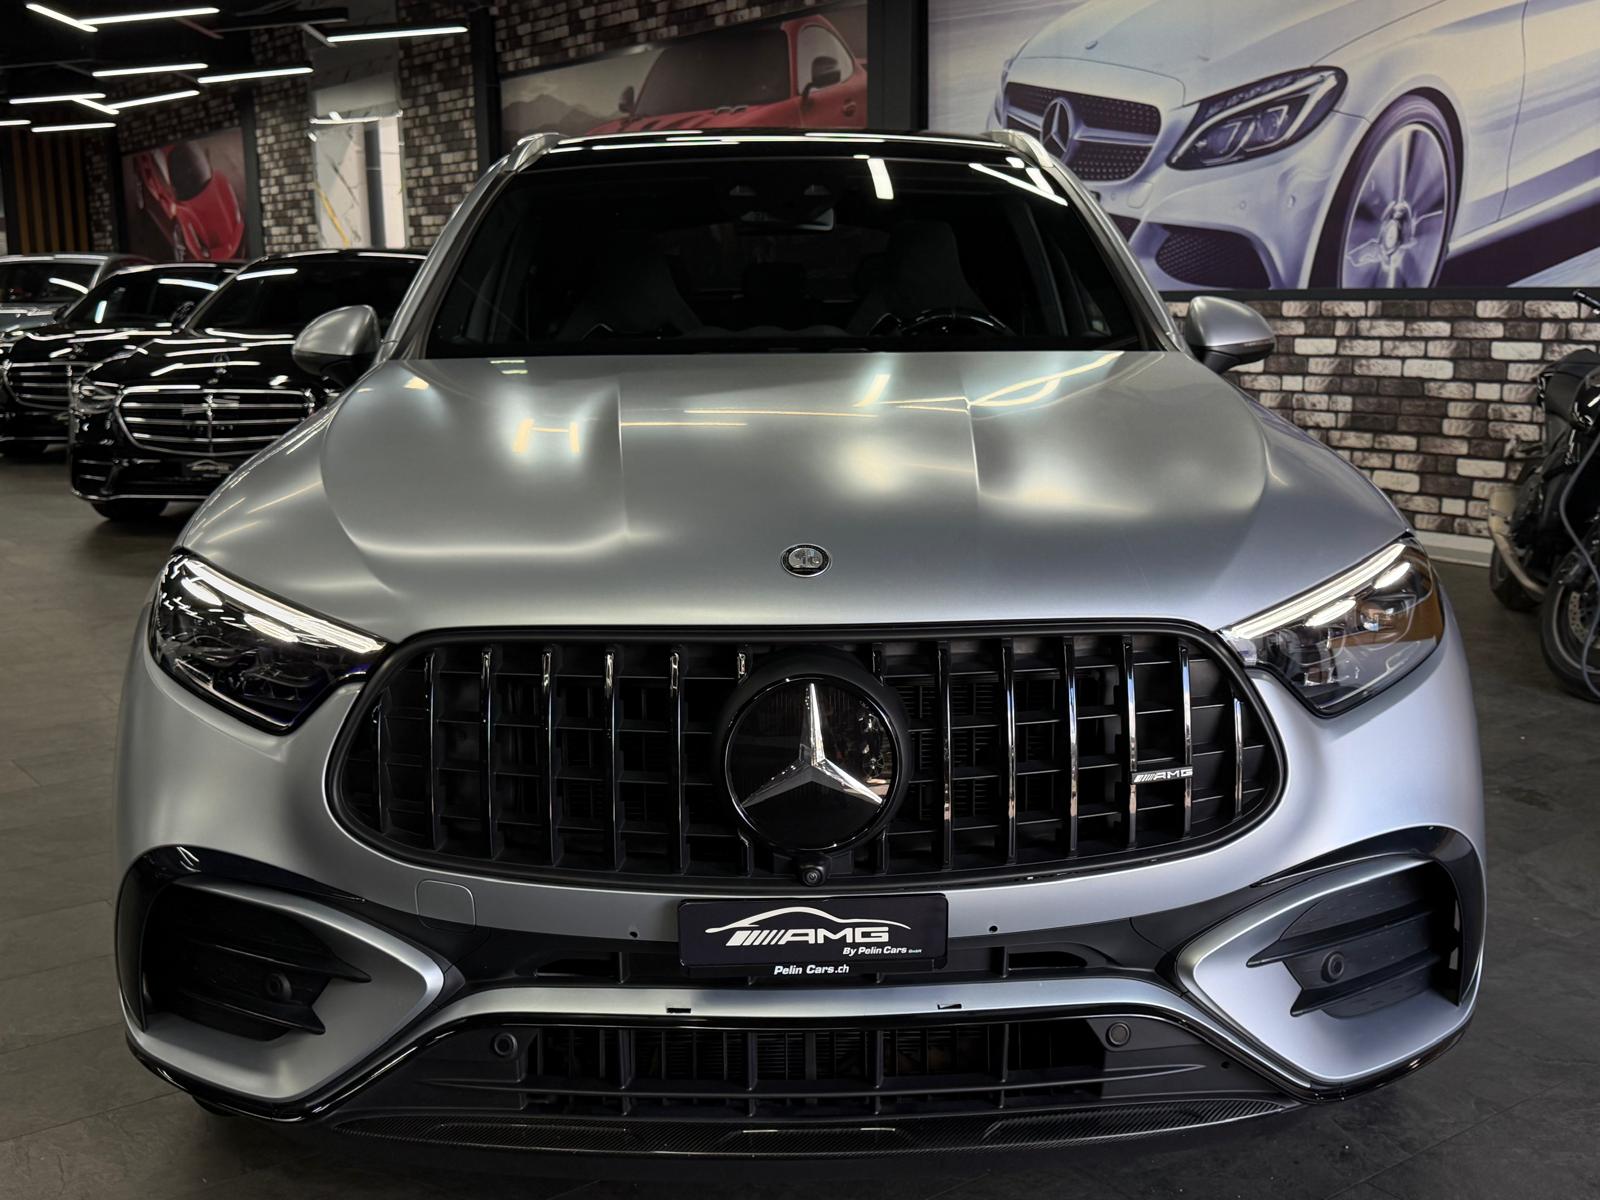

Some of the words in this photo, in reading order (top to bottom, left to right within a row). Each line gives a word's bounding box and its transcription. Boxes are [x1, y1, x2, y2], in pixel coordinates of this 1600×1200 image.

[1152, 768, 1193, 781] AMG
[777, 926, 889, 945] AMG
[843, 947, 856, 956] By
[858, 946, 882, 954] Pelin
[883, 945, 907, 954] Cars
[774, 965, 802, 975] Pelin
[806, 964, 849, 974] Cars.ch
